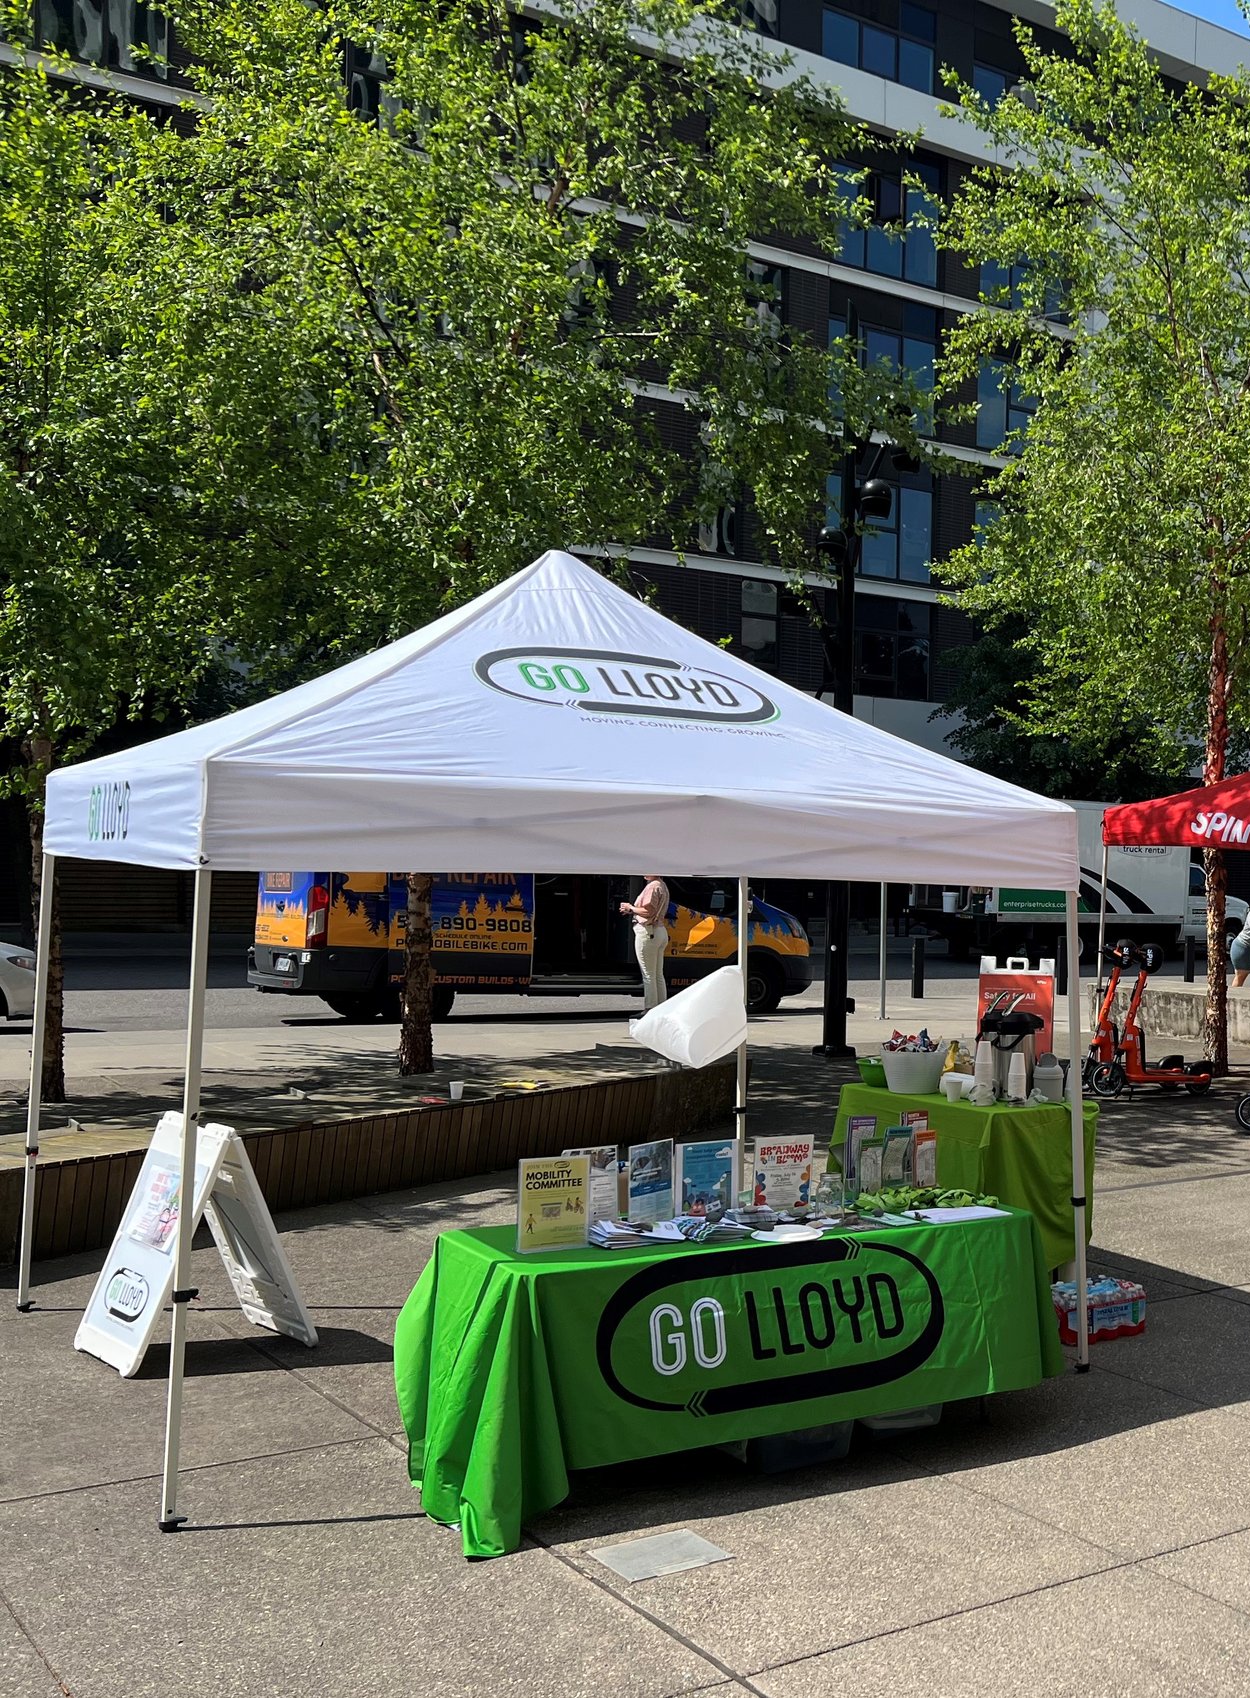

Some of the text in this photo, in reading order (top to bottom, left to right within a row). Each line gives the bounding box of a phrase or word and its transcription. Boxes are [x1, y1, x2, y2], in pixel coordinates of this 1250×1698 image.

[517, 662, 740, 707] GO LLOYD
[88, 780, 131, 841] GO LLOYD
[1144, 846, 1167, 855] rental
[1003, 900, 1067, 909] enterprisetrucks.co
[397, 914, 532, 932] 5-890-9808
[1146, 948, 1154, 967] SPIN
[478, 975, 515, 985] BUILDS
[760, 1144, 810, 1156] BROADWAY
[526, 1169, 572, 1181] MOBILITY
[526, 1178, 583, 1190] COMMITTEE
[118, 1282, 144, 1310] LLOYD
[650, 1273, 904, 1376] GO LLOYD
